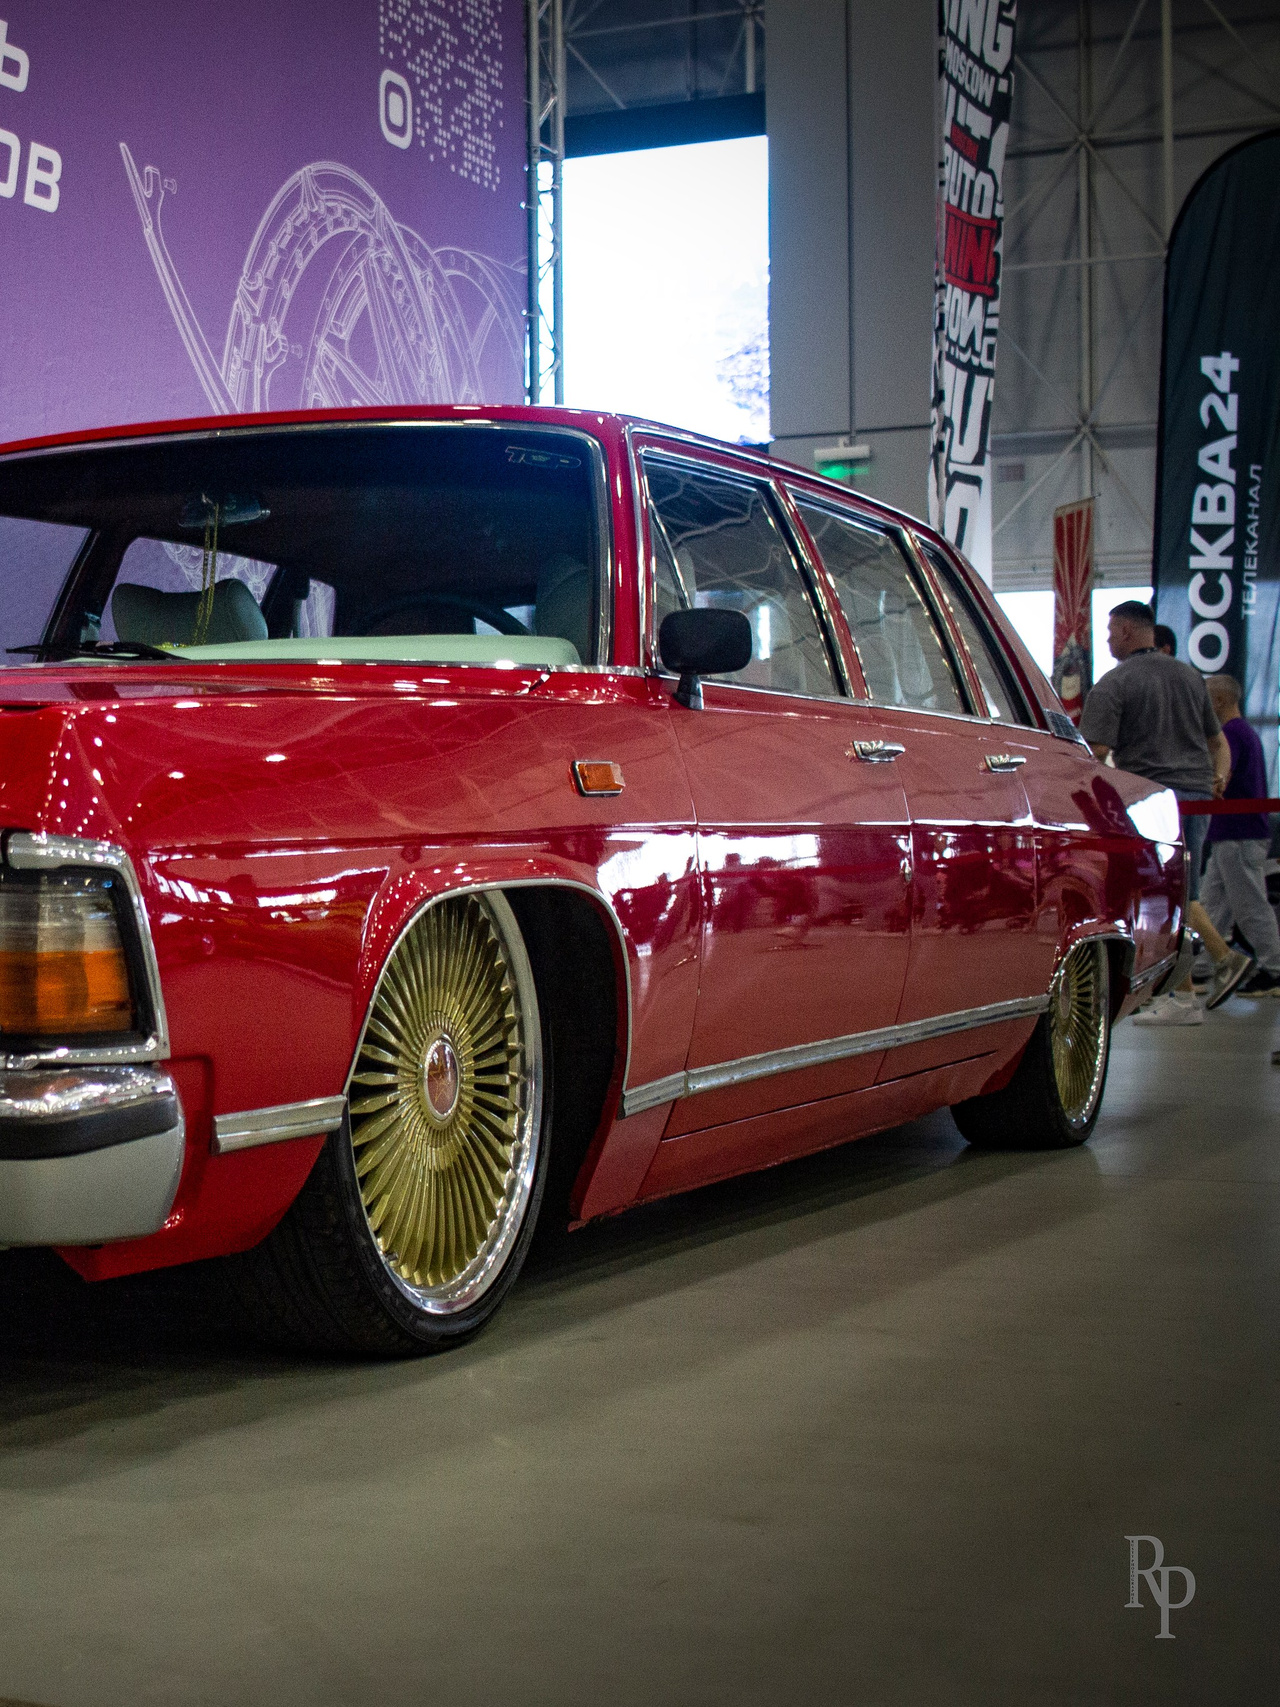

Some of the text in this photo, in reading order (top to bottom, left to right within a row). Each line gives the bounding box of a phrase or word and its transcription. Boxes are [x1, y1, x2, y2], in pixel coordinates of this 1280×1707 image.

[946, 40, 995, 108] MOSCOW
[1188, 351, 1240, 679] ОСКВА24
[1242, 464, 1263, 620] ТЕЛЕКАНАЛ
